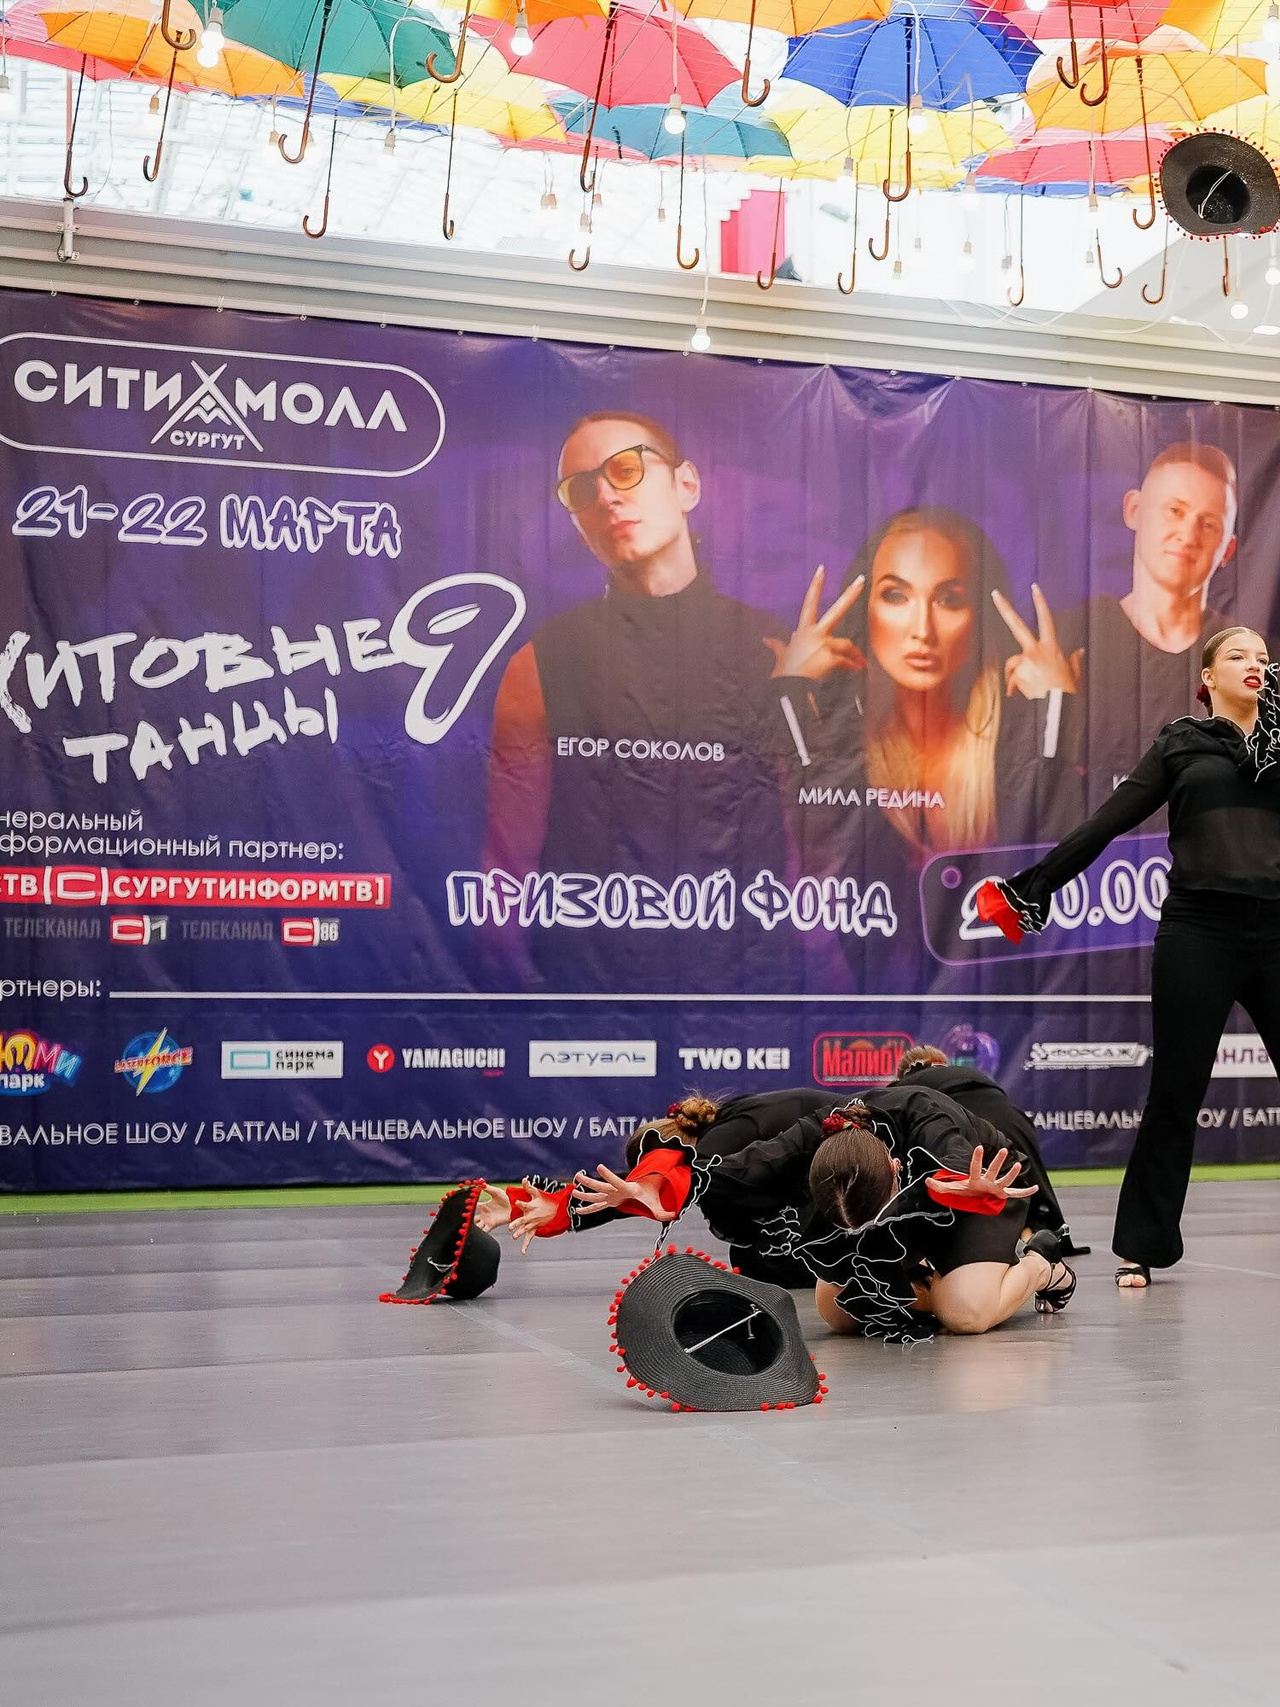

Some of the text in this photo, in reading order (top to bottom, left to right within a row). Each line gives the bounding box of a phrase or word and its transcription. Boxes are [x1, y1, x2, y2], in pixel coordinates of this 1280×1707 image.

[14, 359, 407, 432] СИТИ МОЛЛ
[169, 428, 246, 451] СУРГУТ
[12, 484, 403, 559] 21-22 МАРТА
[62, 686, 338, 784] ТАНЦЫ
[556, 735, 726, 762] ЕГОР СОКОЛОВ
[798, 786, 946, 810] МИЛА РЕДИНА
[228, 841, 344, 863] партнер:
[446, 868, 736, 930] ПРИЗОВОЙ
[742, 869, 897, 936] ФОНД
[4, 916, 101, 939] ТЕЛЕКАНАЛ
[182, 919, 273, 940] ТЕЛЕКАНАЛ
[0, 979, 102, 1002] ртнеры:
[276, 1049, 334, 1060] синема
[402, 1048, 506, 1069] YAMAGUCHI
[679, 1047, 790, 1070] TWO KEI
[276, 1060, 315, 1073] парк
[0, 1122, 118, 1146] ВАЛЬНОЕ
[126, 1121, 188, 1145] ШОУ
[212, 1120, 300, 1143] БАТТЛЫ
[323, 1117, 505, 1142] ТАНЦЕВАЛЬНОЕ
[511, 1117, 568, 1138] ШОУ
